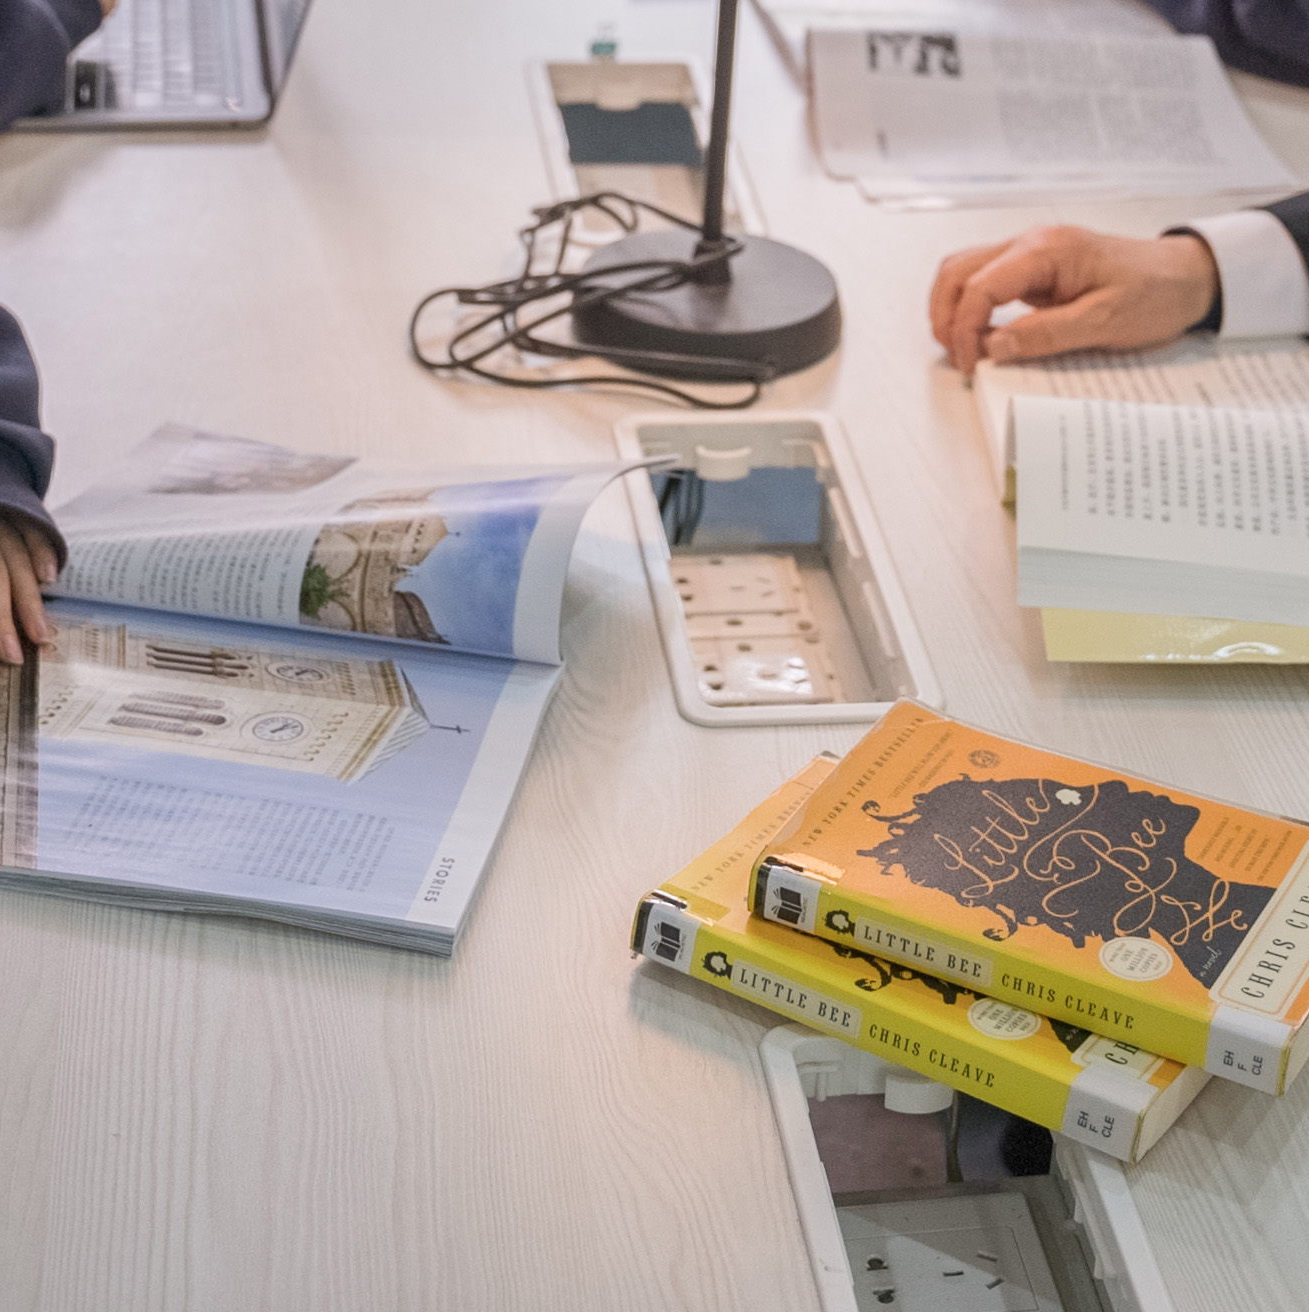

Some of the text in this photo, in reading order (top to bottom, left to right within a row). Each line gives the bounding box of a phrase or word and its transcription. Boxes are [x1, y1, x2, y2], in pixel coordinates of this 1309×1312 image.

[802, 716, 925, 848] NEW YORK TIMES BESTSELLER
[933, 778, 1054, 898] Little
[691, 872, 715, 893] NEW
[716, 850, 745, 873] YORK
[745, 822, 778, 851] TIMES
[423, 856, 456, 903] STORIES
[1128, 946, 1149, 971] MILLION
[1241, 937, 1296, 999] CHRIS
[862, 924, 1135, 1030] LITTLE BEE CHRIS CLEAVE
[739, 968, 996, 1089] LITTLE BEE CHRIS CLEAVE
[1222, 1050, 1235, 1067] EH
[1237, 1062, 1248, 1071] F
[1251, 1054, 1264, 1076] CLE
[1077, 1110, 1089, 1128] EH
[1090, 1123, 1099, 1134] F
[1101, 1115, 1115, 1138] CLE
